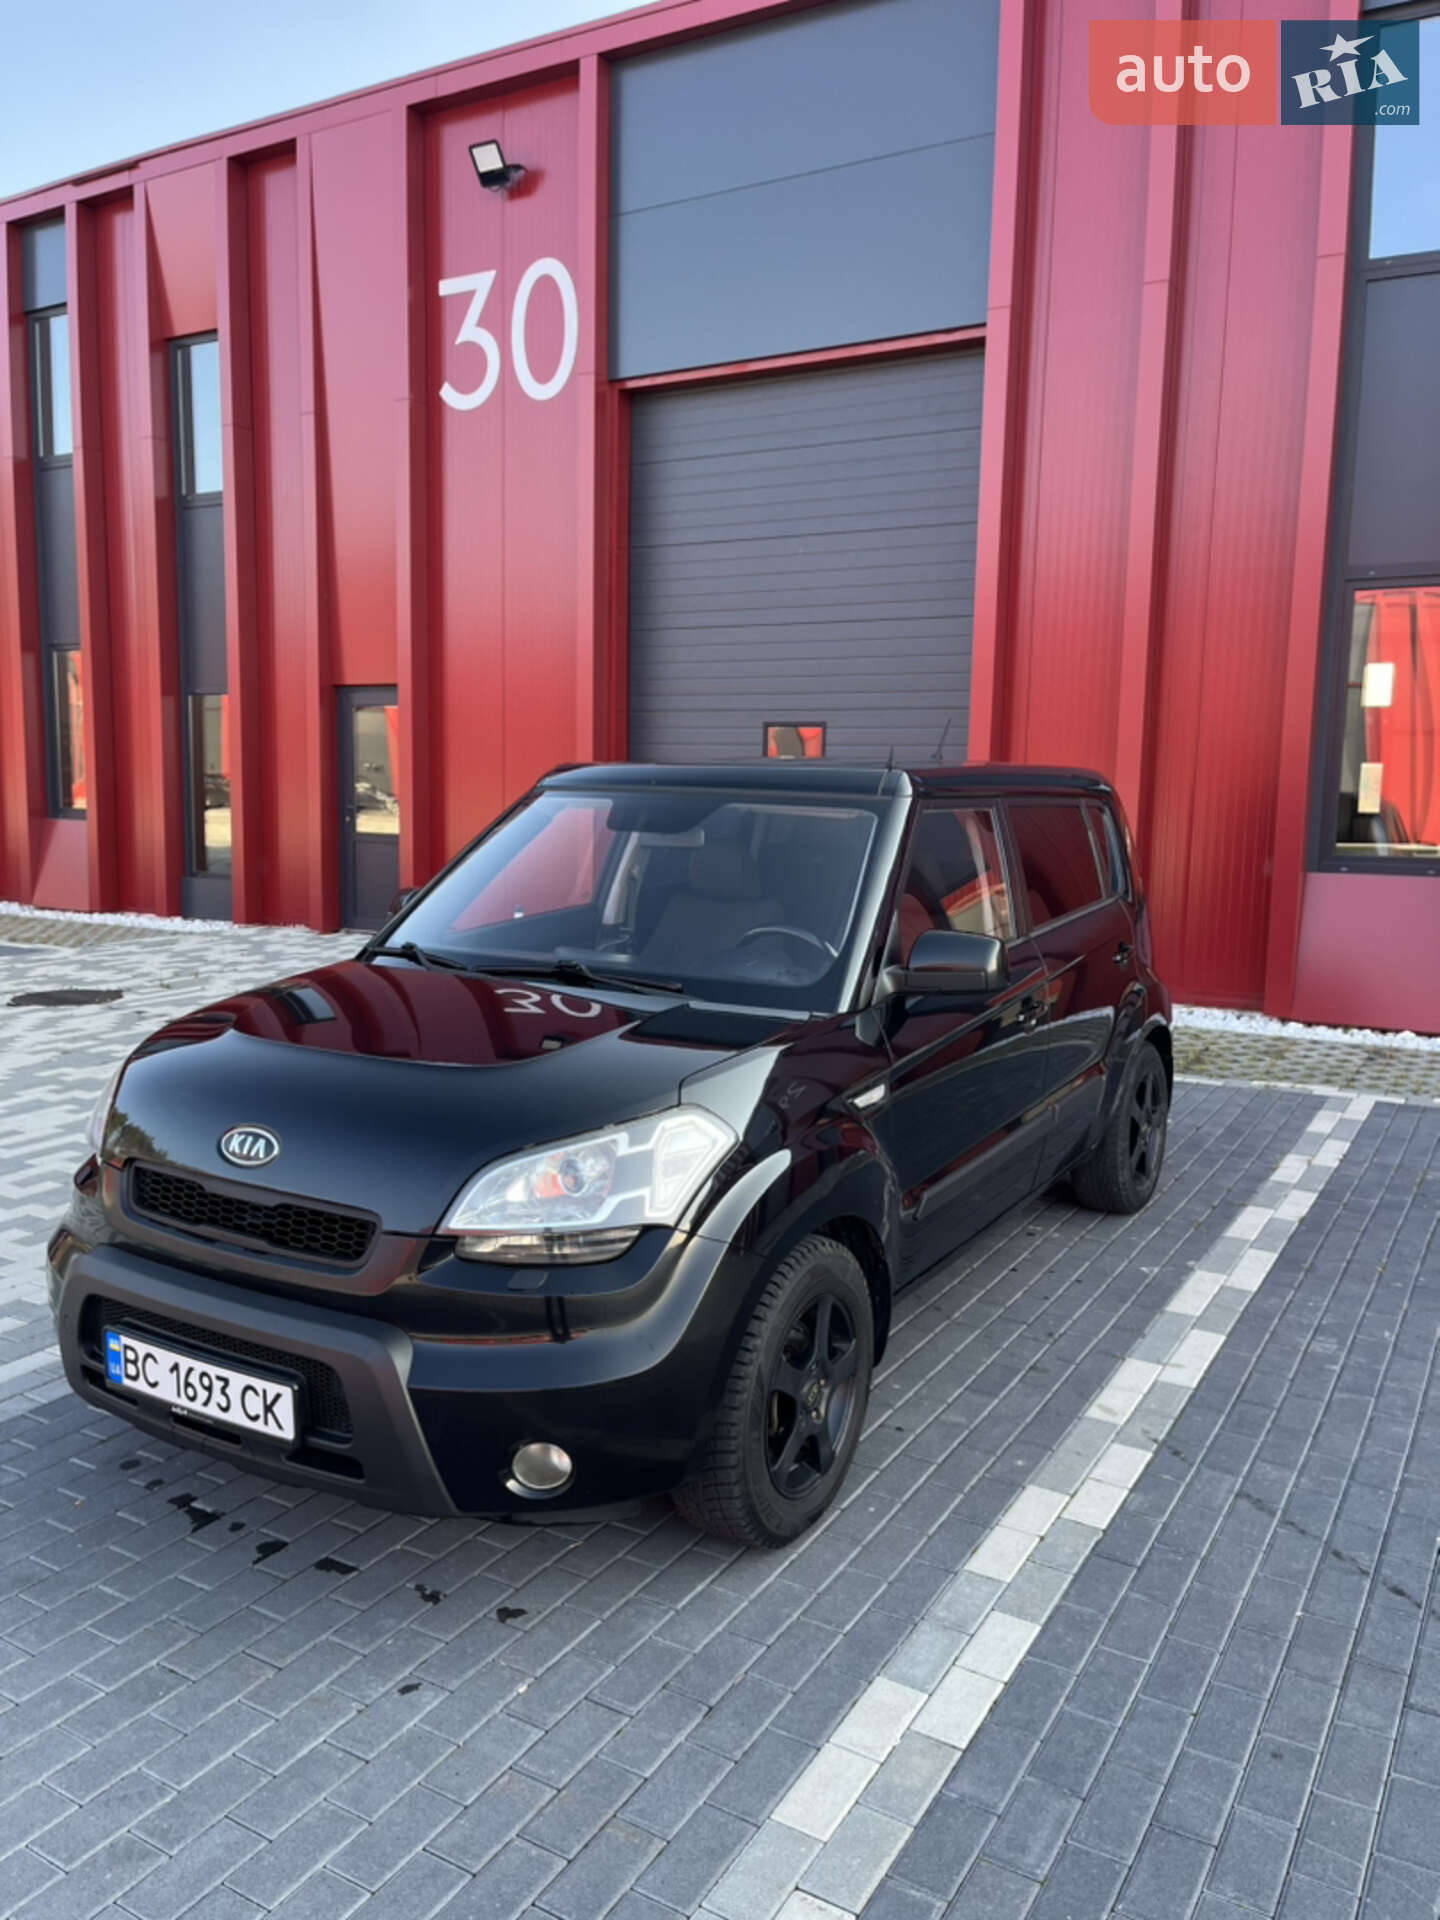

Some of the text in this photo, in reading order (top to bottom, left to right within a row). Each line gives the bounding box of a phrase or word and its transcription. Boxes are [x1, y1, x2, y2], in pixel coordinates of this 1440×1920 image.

[438, 256, 579, 411] 30
[228, 1132, 266, 1159] KIA
[122, 1344, 159, 1388] BC
[168, 1362, 231, 1413] 1693
[240, 1384, 284, 1430] CK
